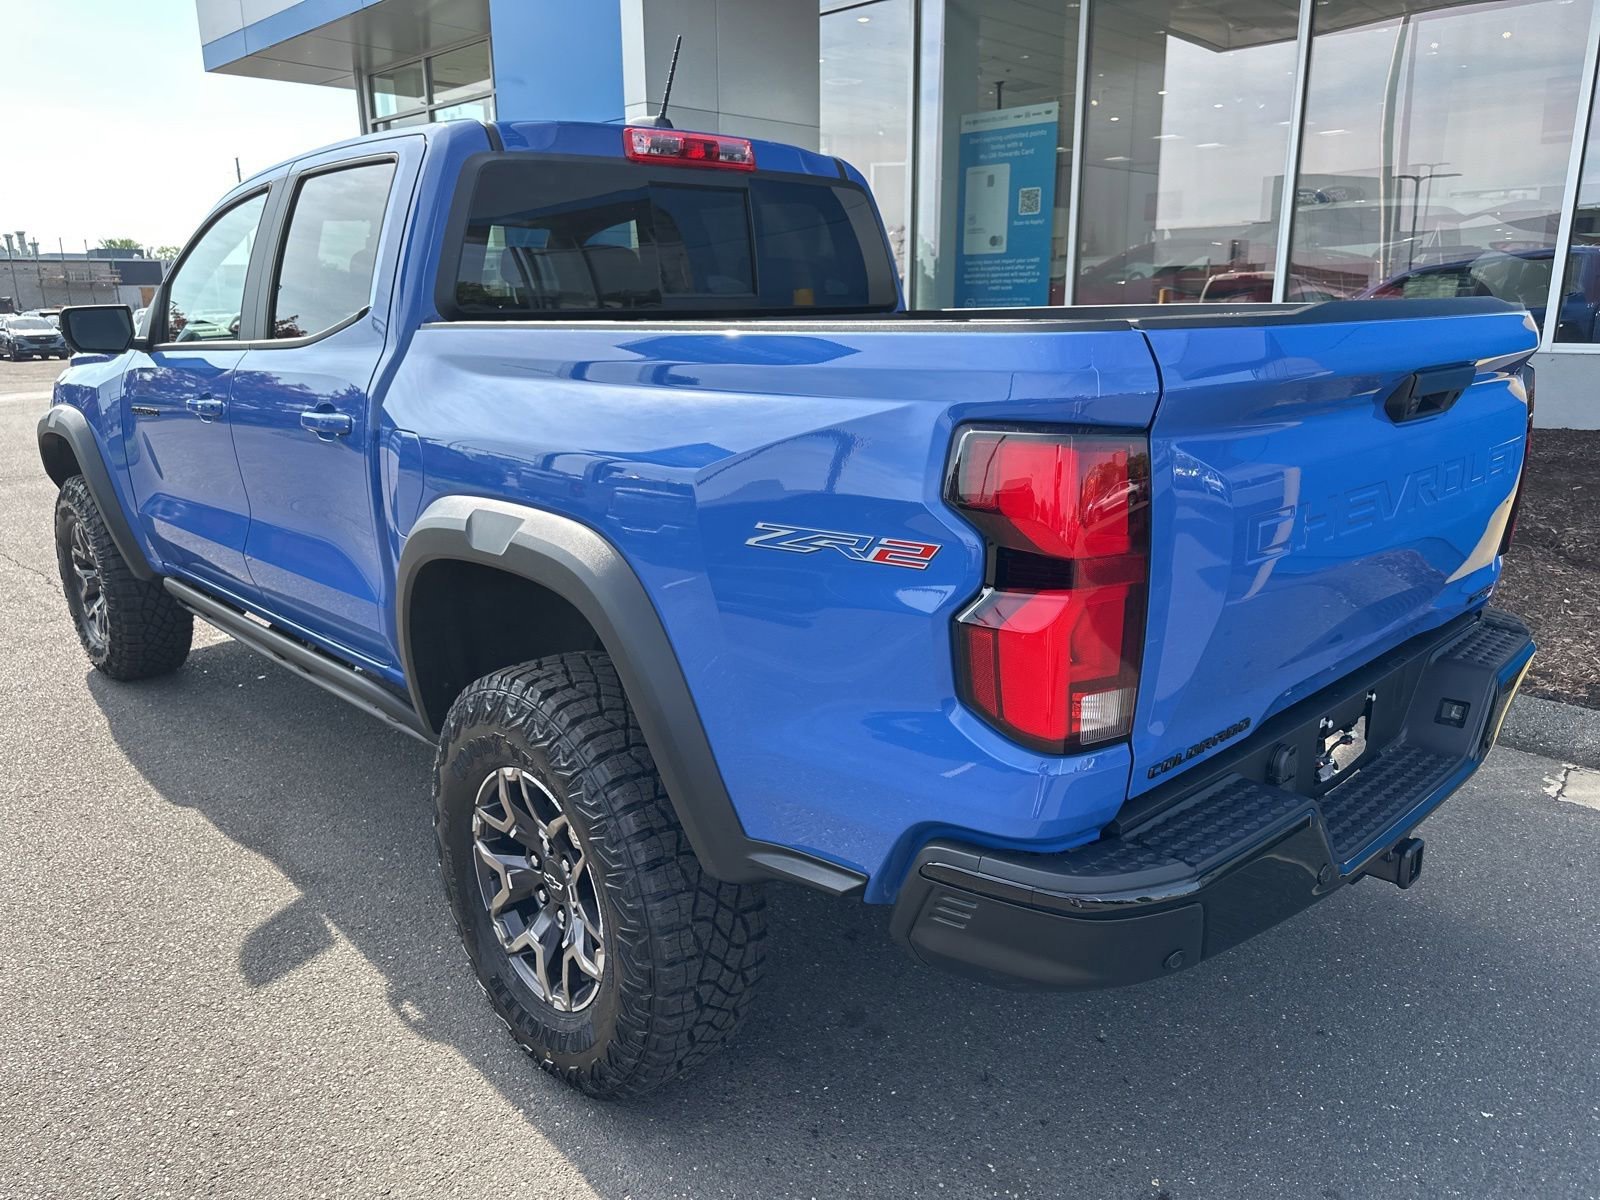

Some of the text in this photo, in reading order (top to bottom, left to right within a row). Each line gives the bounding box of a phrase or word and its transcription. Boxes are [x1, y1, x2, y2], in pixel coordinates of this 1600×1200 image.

[1029, 129, 1047, 138] points
[1246, 435, 1523, 566] CHEVROLET
[745, 521, 942, 570] ZR2
[1147, 716, 1252, 780] COLORADO
